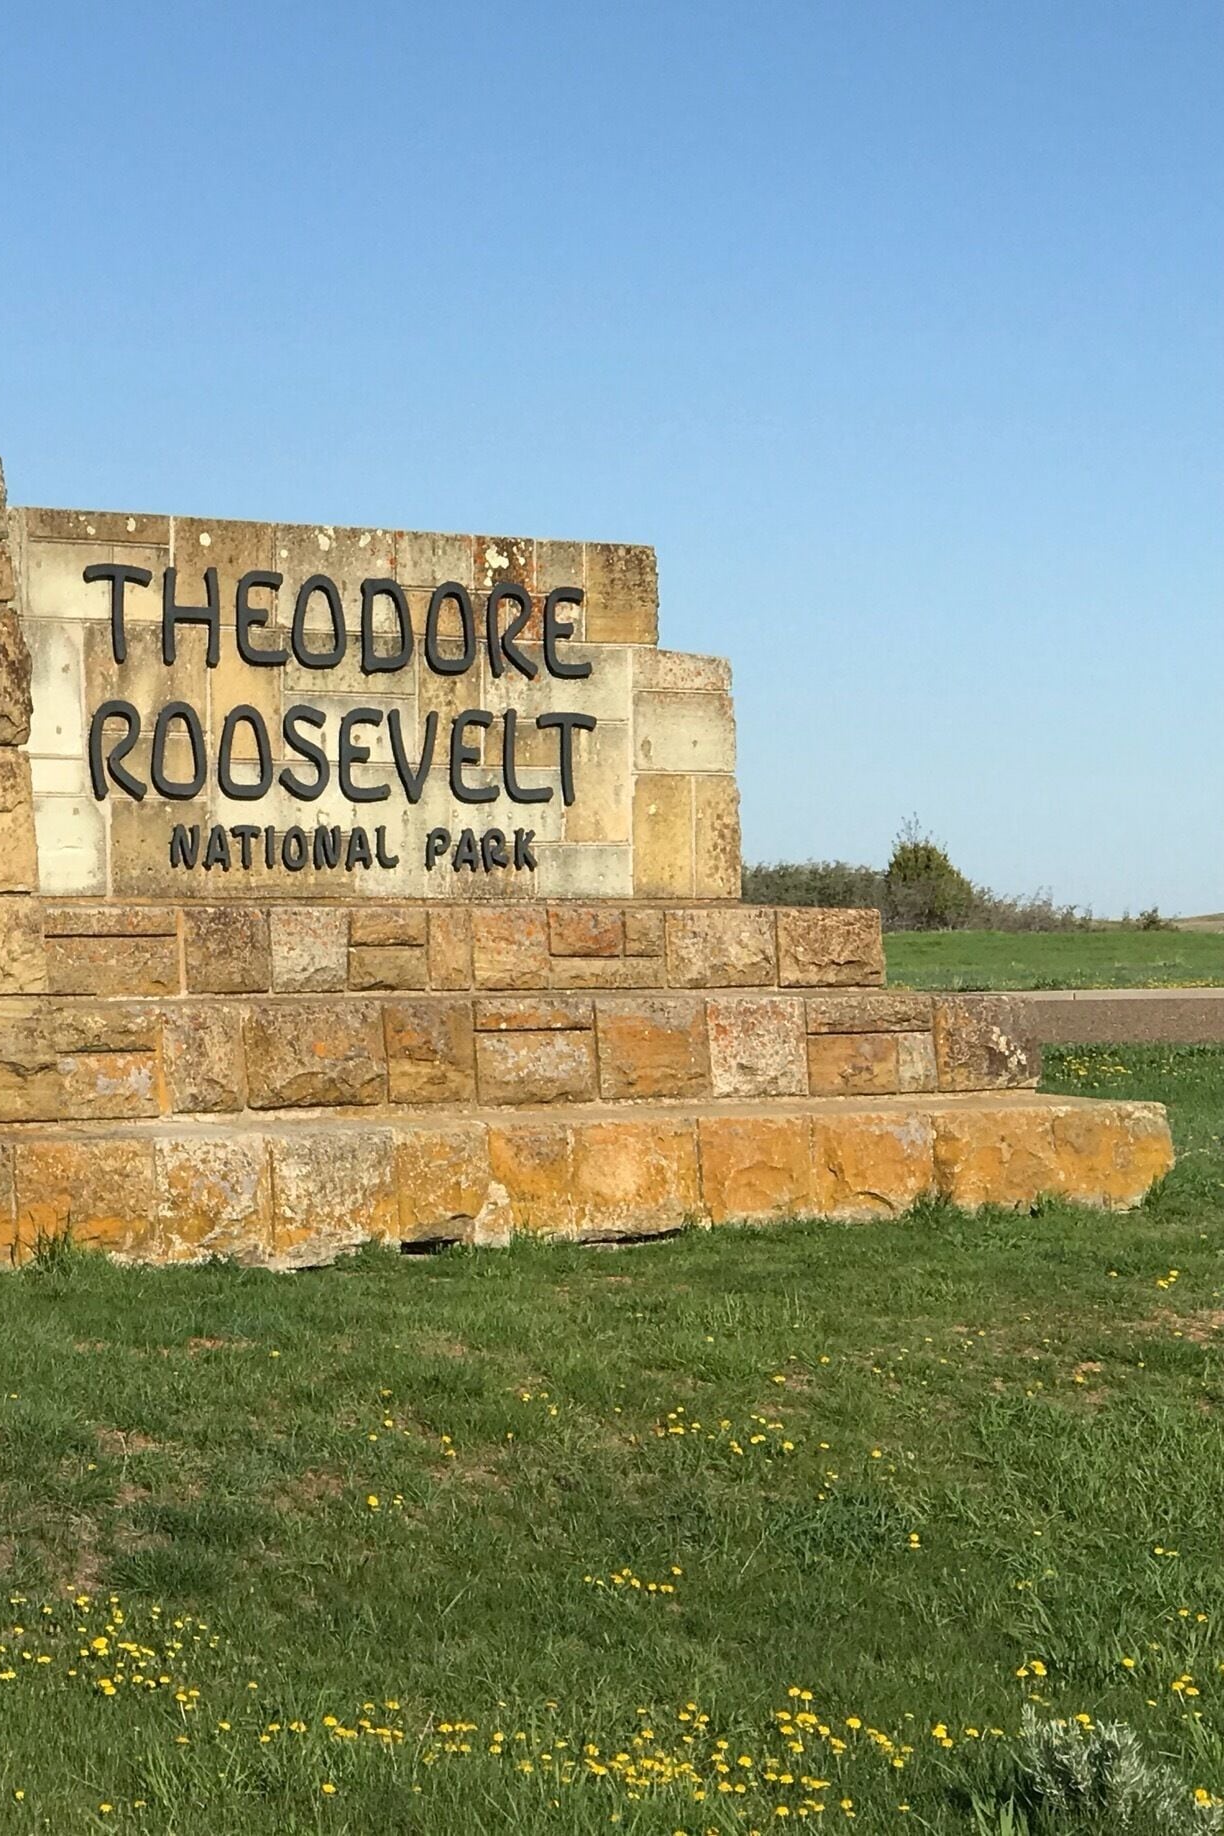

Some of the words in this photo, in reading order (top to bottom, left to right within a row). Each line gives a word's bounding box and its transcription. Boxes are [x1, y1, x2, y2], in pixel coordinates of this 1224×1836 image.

[83, 563, 592, 680] THEODORE
[88, 700, 597, 806] ROOSEVELT
[169, 824, 400, 872] NATIONAL
[425, 827, 538, 872] PARK
